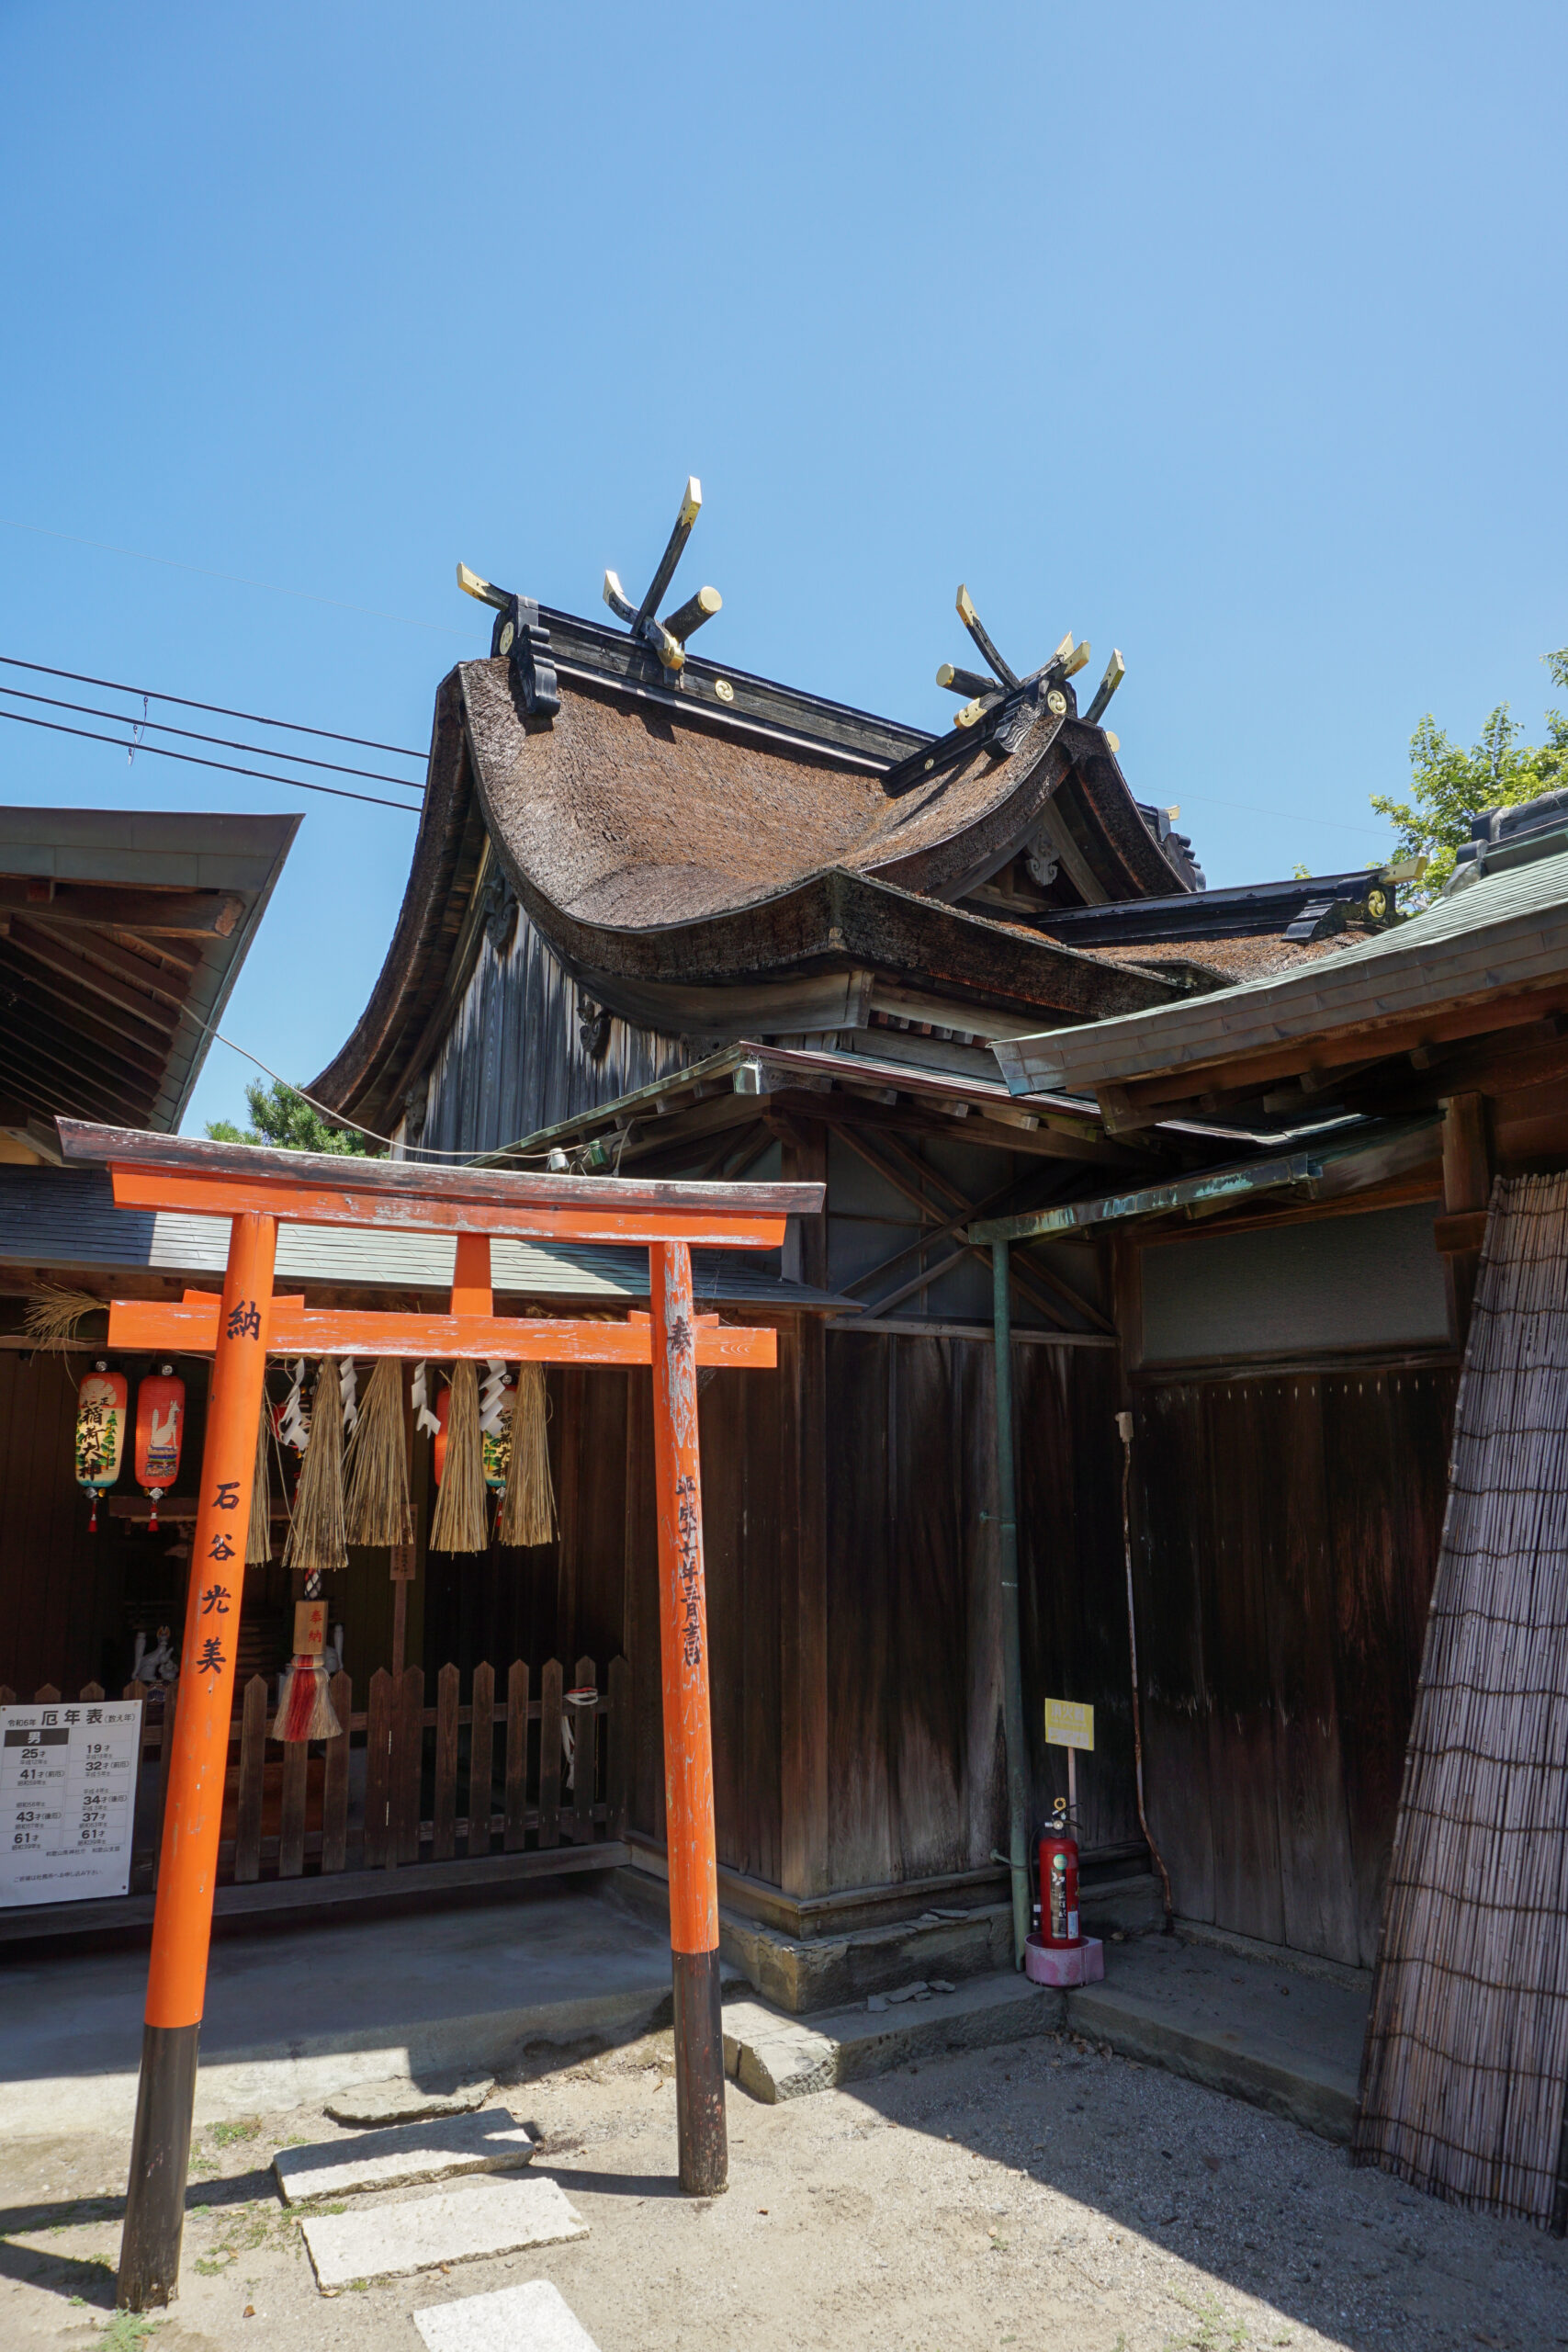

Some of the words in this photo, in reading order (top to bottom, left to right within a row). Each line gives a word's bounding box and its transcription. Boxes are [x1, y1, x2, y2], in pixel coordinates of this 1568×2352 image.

[226, 1299, 262, 1341] 納
[667, 1315, 693, 1356] 奉
[196, 1482, 241, 1675] 石谷光美
[309, 1609, 323, 1644] 奉納
[7, 1719, 37, 1727] 令和6年
[28, 1731, 41, 1744] 男
